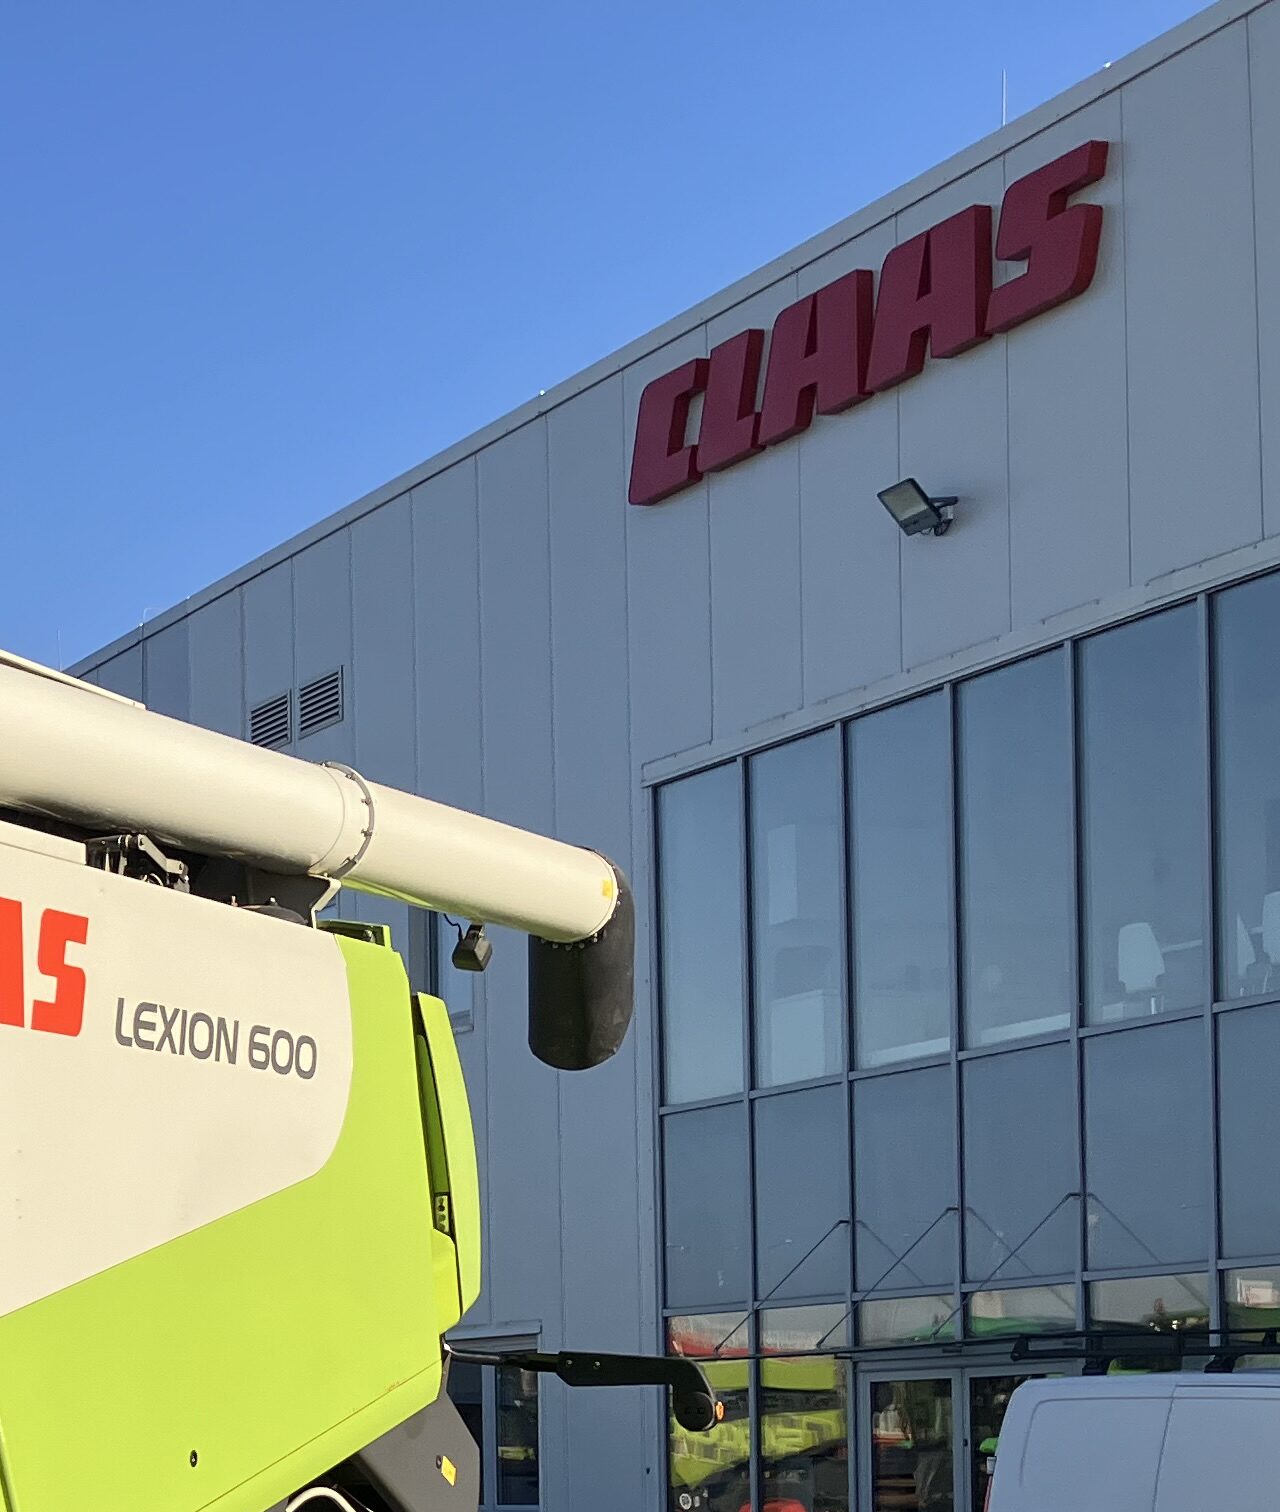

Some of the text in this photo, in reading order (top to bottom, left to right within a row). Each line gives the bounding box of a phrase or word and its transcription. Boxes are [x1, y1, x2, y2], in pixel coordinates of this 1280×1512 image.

[627, 138, 1109, 507] CLAAS
[115, 996, 318, 1081] LEXION 600
